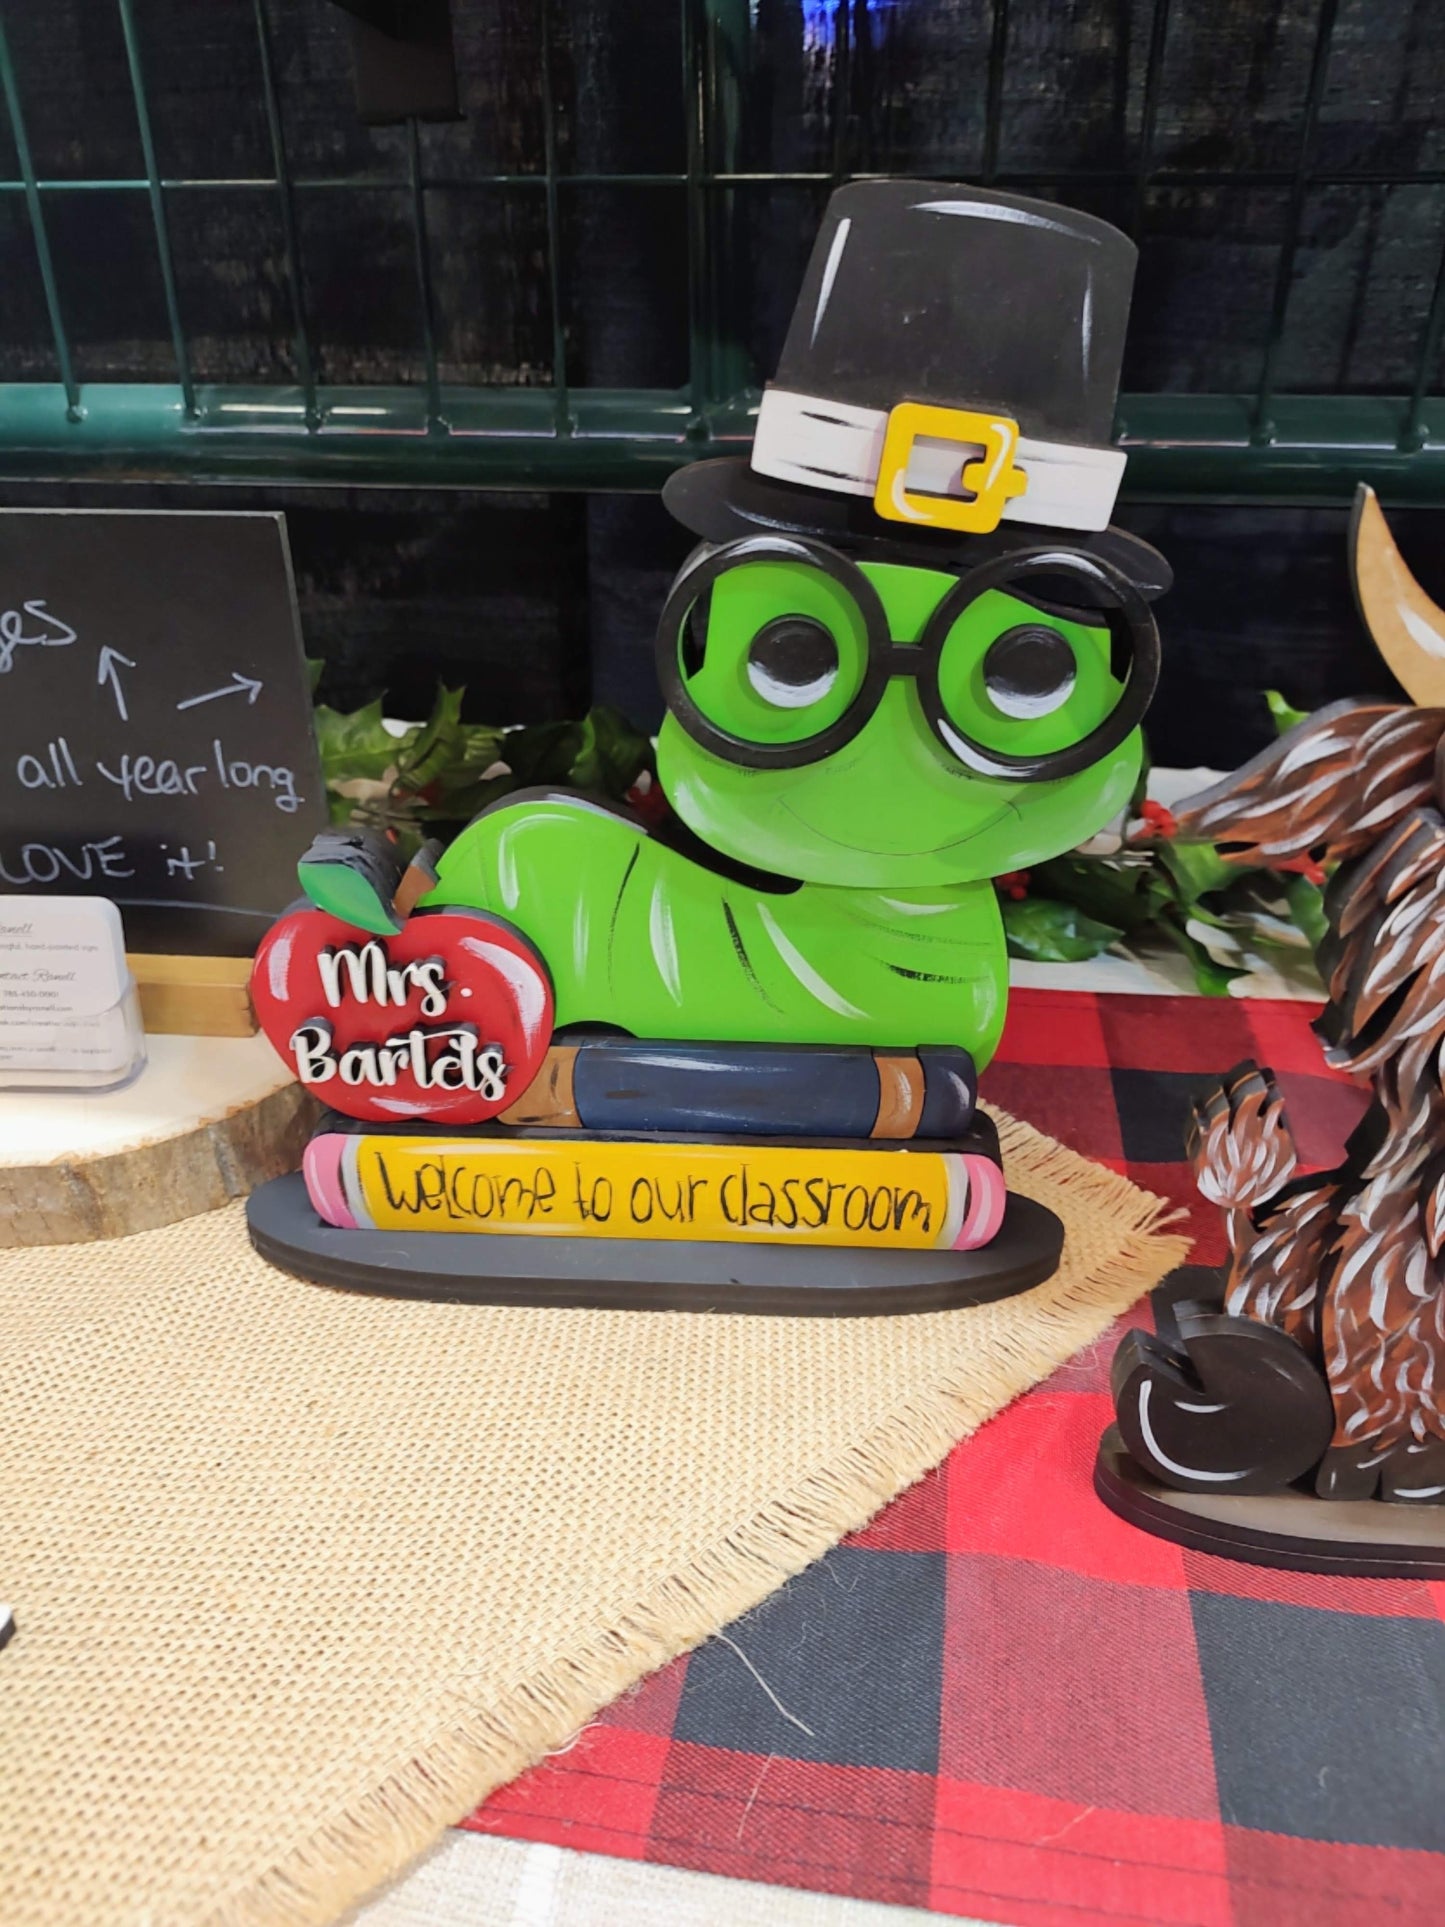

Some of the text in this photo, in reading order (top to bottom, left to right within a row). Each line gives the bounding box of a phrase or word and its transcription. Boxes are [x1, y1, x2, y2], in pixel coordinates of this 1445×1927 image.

[17, 737, 83, 788] all
[160, 841, 224, 880] it!
[316, 940, 473, 1017] Mrs.
[289, 1025, 507, 1102] Bartels
[374, 1151, 931, 1232] Welcome to our classroom
